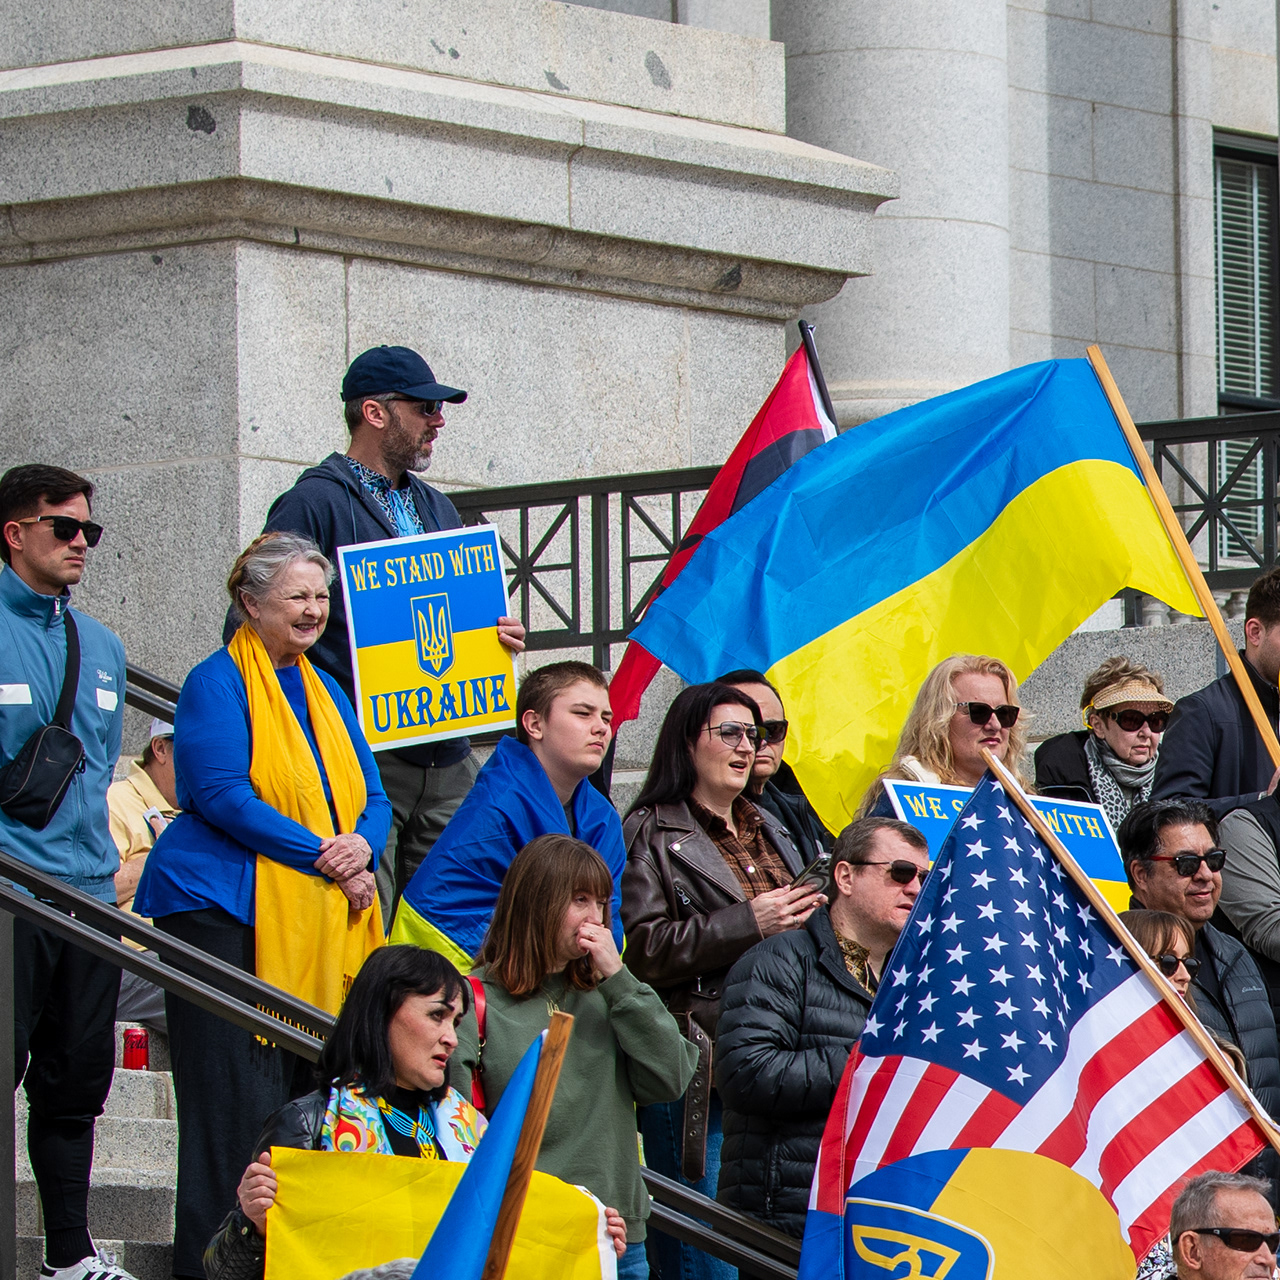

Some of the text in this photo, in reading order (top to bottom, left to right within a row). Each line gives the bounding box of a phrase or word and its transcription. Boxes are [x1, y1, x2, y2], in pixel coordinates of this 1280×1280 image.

[349, 543, 496, 592] WE STAND WITH
[368, 673, 511, 733] UKRAINE
[903, 792, 949, 820] WE
